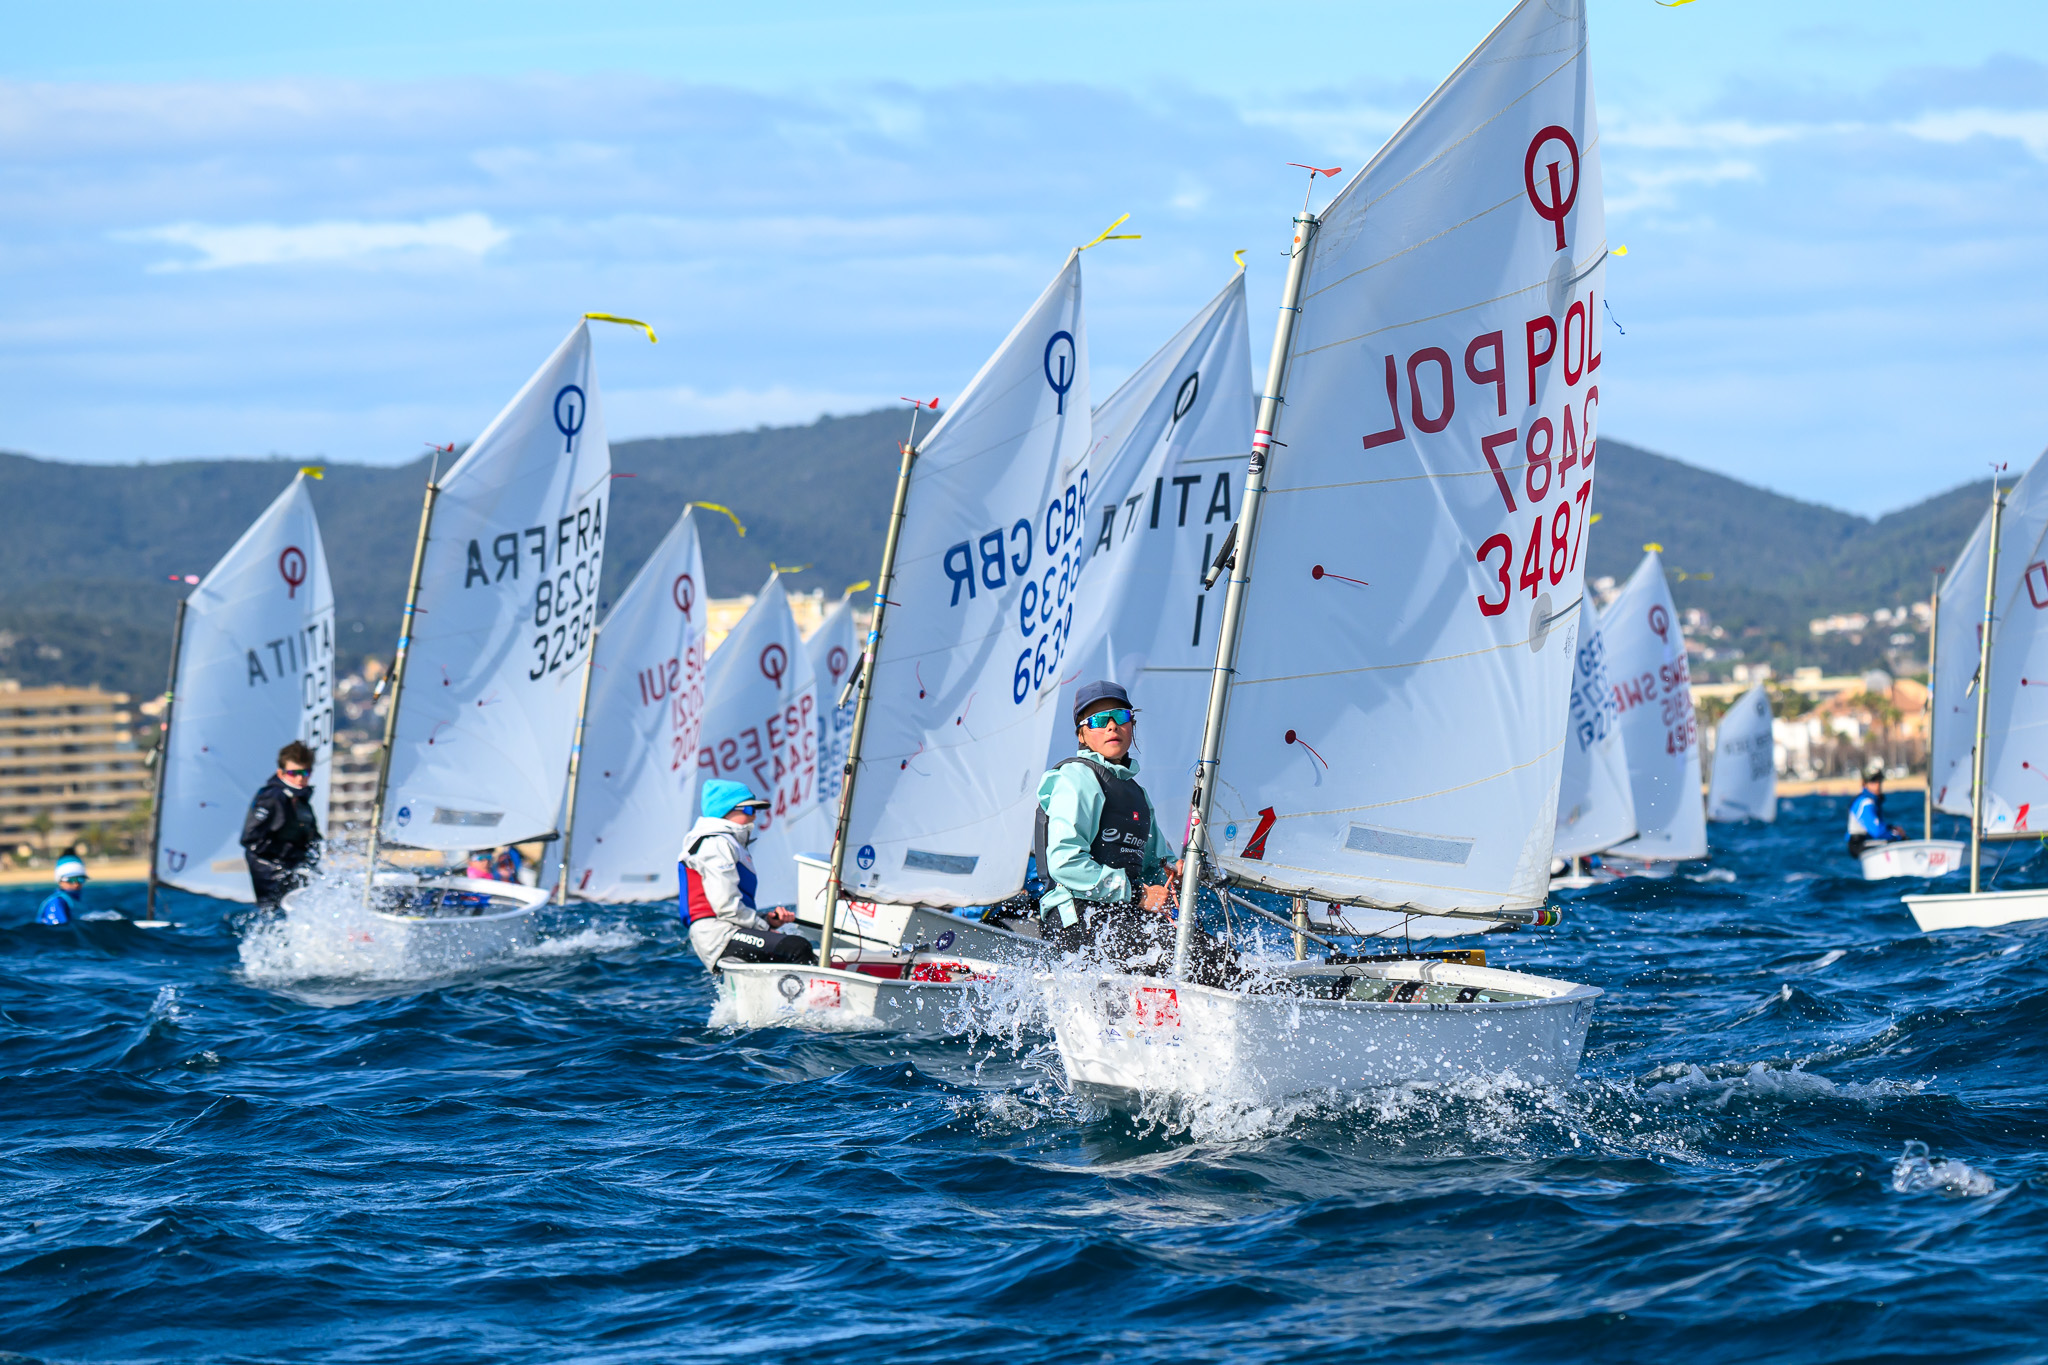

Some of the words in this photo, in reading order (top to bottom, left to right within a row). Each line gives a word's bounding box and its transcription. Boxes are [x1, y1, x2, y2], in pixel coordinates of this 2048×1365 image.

[1526, 290, 1602, 406] POL
[557, 498, 602, 566] FRA
[1045, 469, 1089, 556] GBR
[1149, 472, 1231, 530] ITA
[1476, 479, 1592, 617] 3487
[530, 604, 593, 681] 3238
[766, 694, 813, 750] ESP
[1123, 832, 1147, 849] Ener
[731, 932, 766, 948] MUSTO
